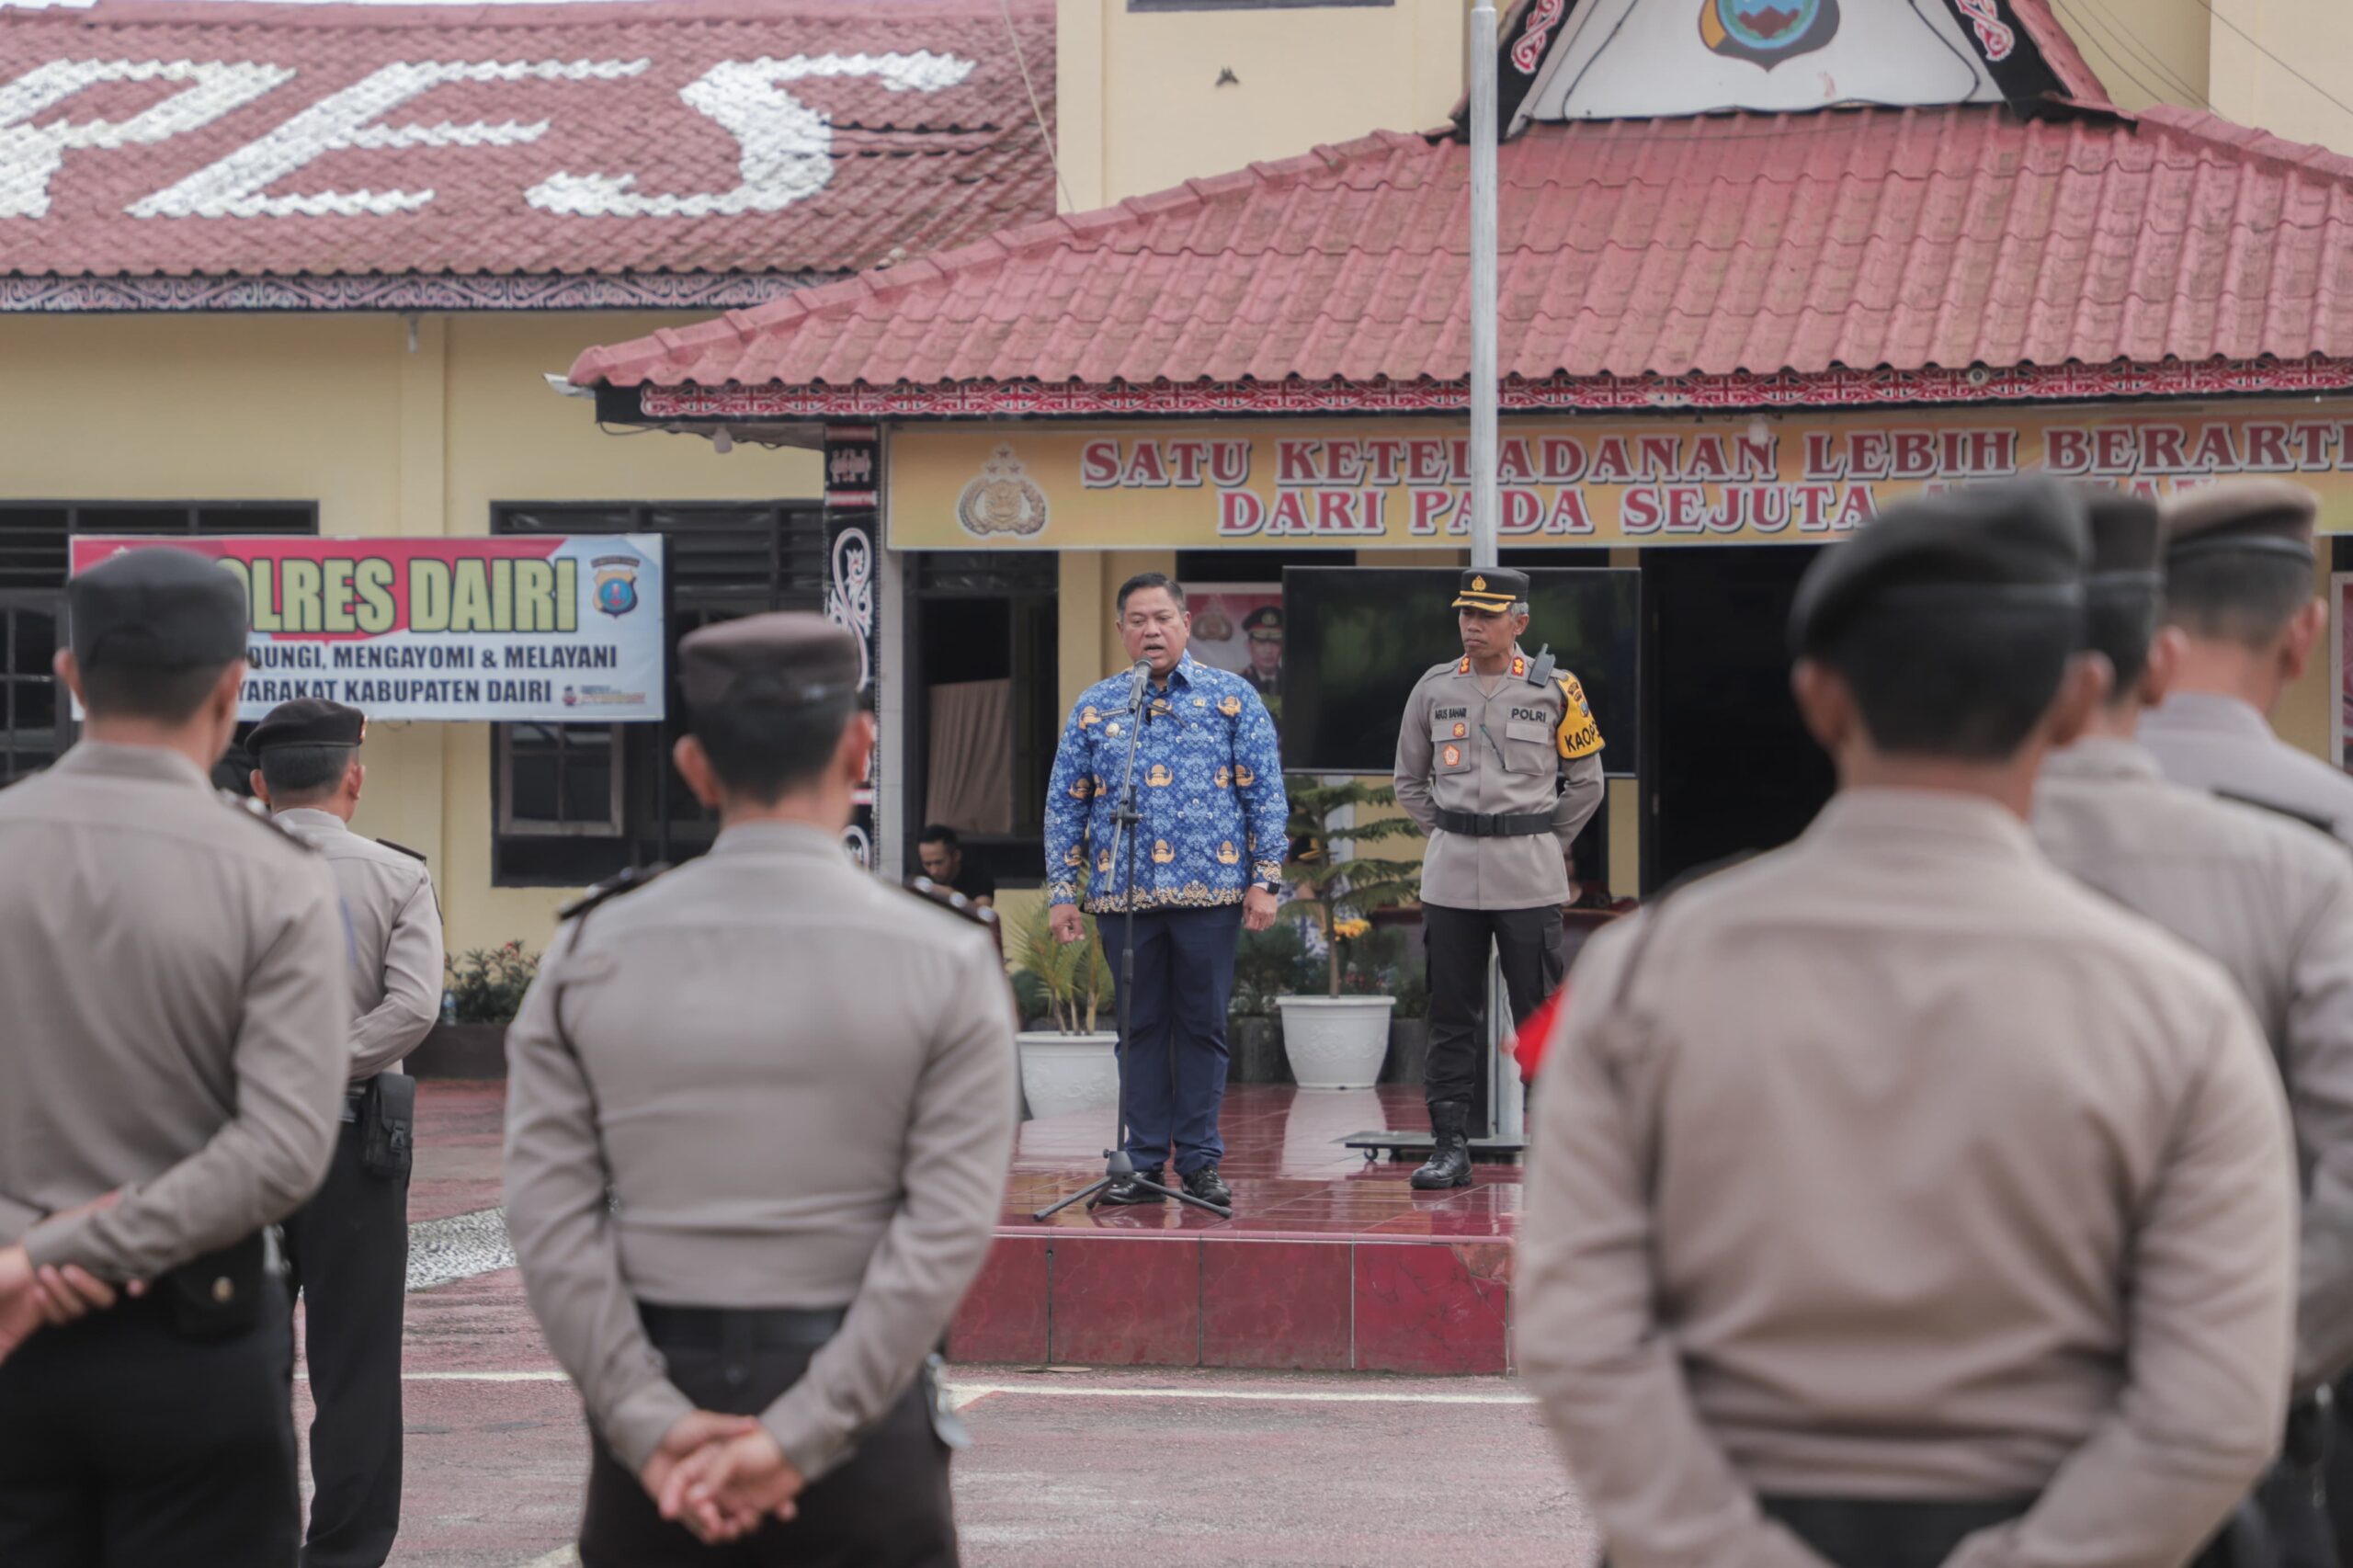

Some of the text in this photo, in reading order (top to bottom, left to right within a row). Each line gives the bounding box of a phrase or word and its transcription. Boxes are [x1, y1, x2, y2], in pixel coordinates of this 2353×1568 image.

[1081, 420, 2353, 488] SATU KETELADANAN LEBIH BERARTI
[1218, 489, 1385, 537] DARI
[1410, 487, 1595, 535] PADA
[1621, 483, 1881, 534] SEJUTA
[409, 557, 577, 633] DAIRI
[334, 645, 474, 669] MENGAYOMI
[481, 649, 498, 669] &
[505, 645, 618, 669] MELAYANI
[345, 679, 480, 702] KABUPATEN
[487, 679, 551, 702] DAIRI
[1511, 708, 1547, 722] POLRI
[1564, 721, 1599, 753] KAOP
